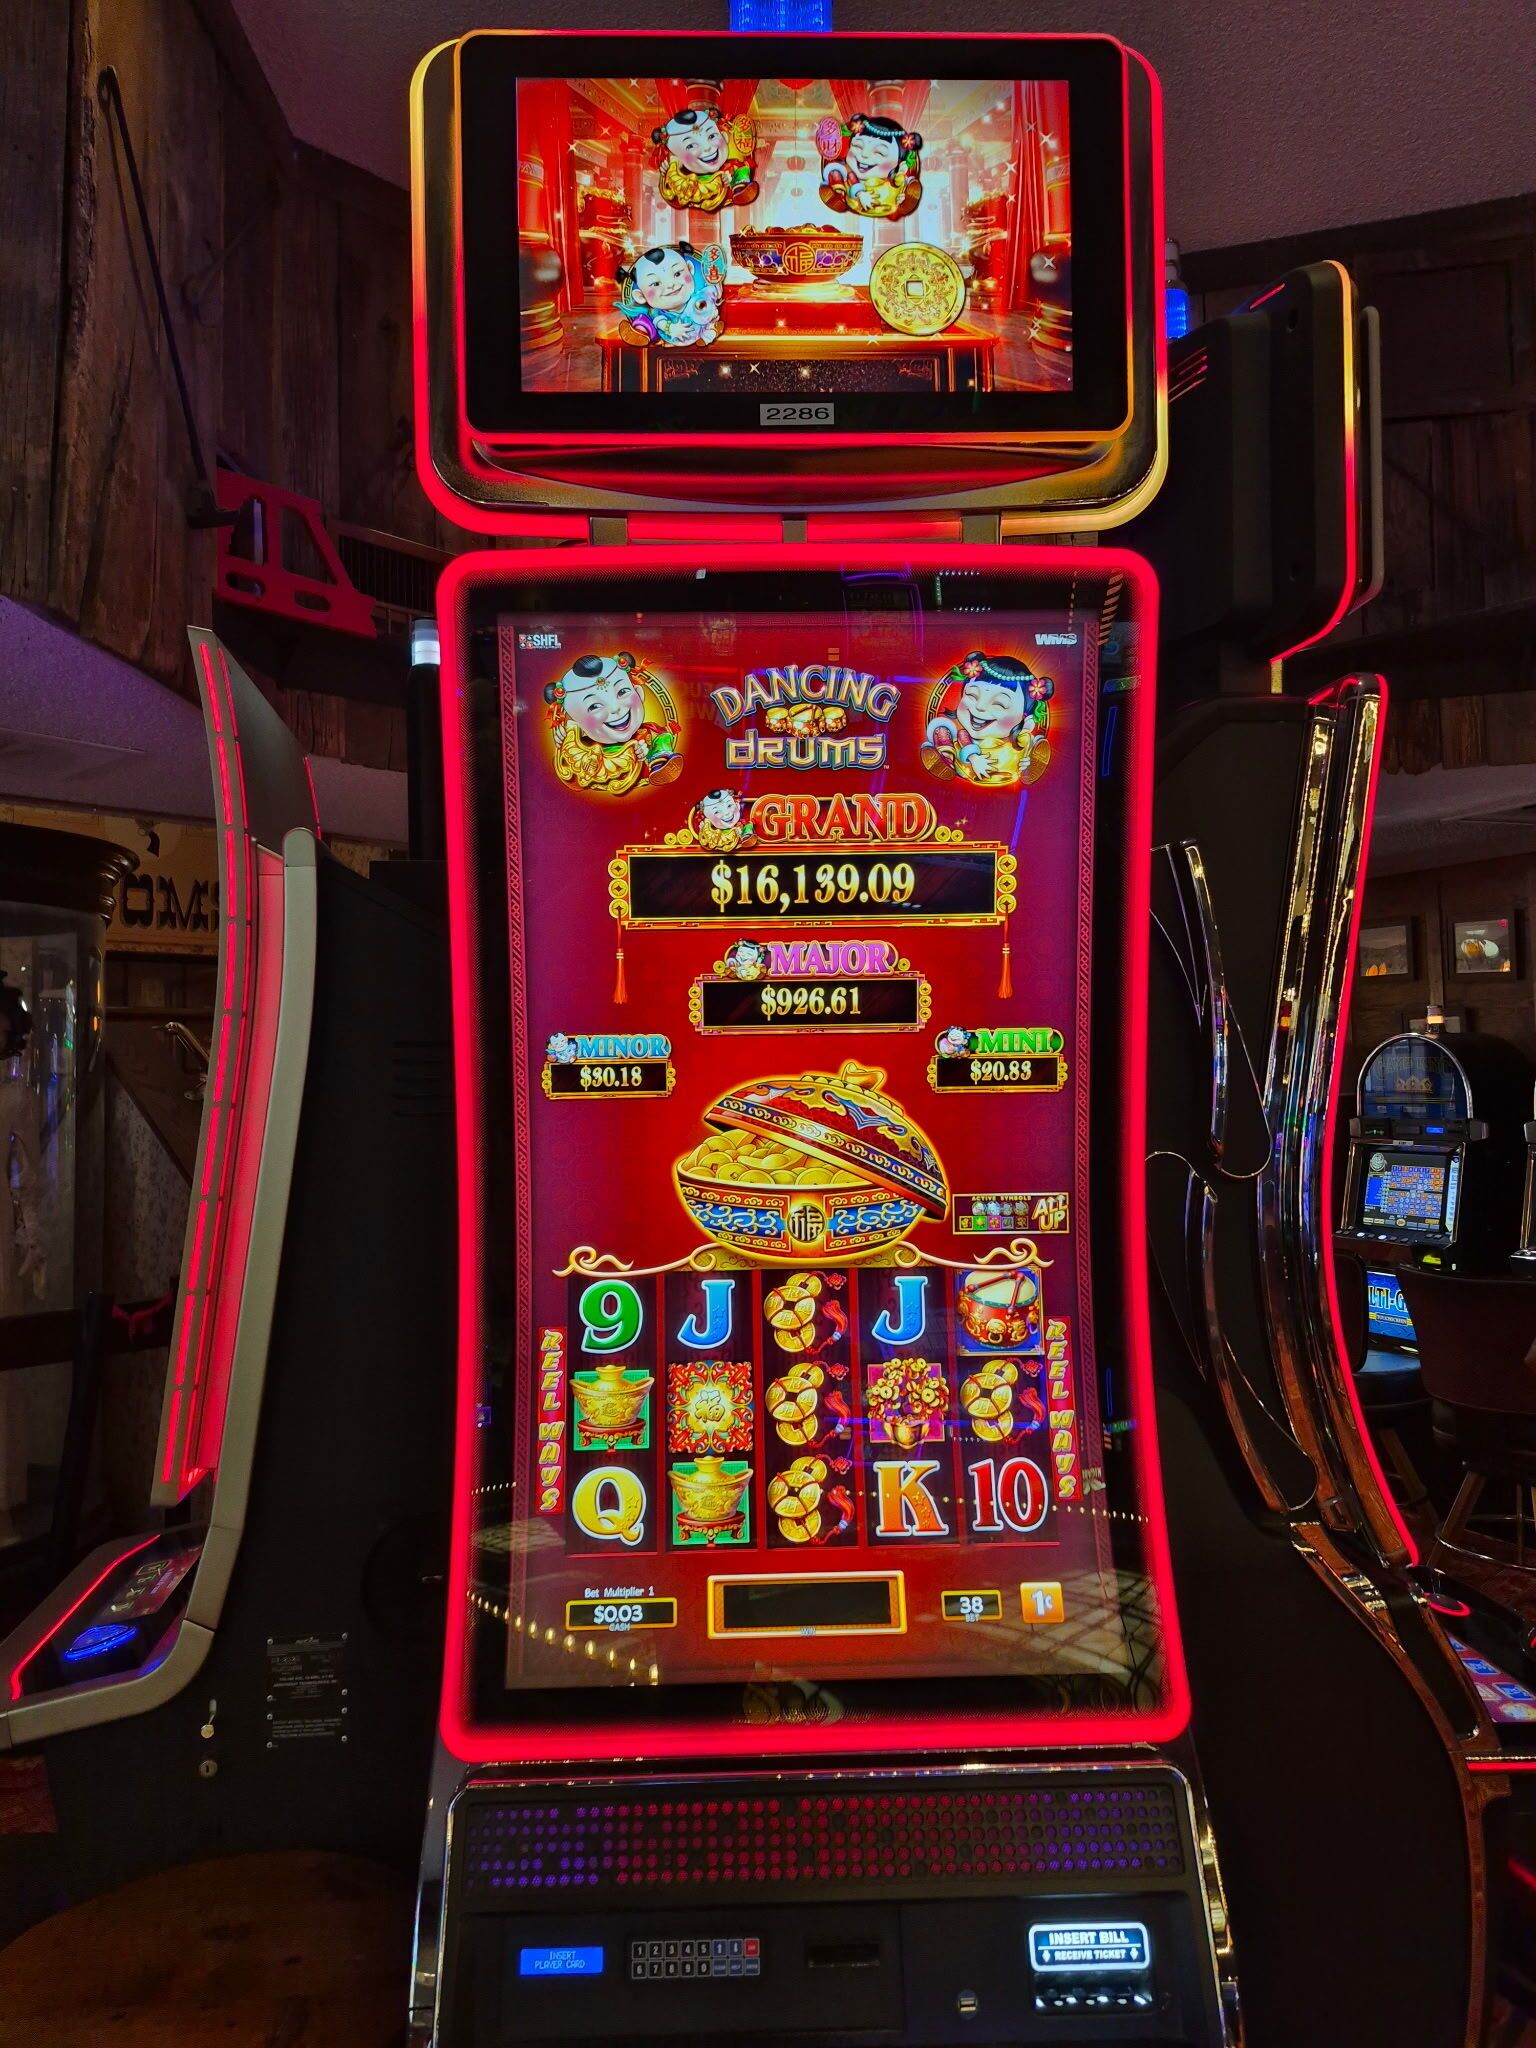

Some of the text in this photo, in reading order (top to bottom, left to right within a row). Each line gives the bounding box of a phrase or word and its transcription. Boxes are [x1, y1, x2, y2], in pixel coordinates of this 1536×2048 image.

[766, 407, 829, 420] 2286
[533, 634, 562, 646] SHFL
[1034, 633, 1078, 645] WMS
[710, 664, 901, 727] DANCING
[750, 793, 931, 843] GRAND
[711, 859, 915, 914] $16,139.09
[768, 940, 894, 976] MAJOR
[761, 984, 861, 1021] $926.61
[575, 1034, 669, 1059] MINOR
[975, 1028, 1054, 1054] MINI
[580, 1065, 642, 1091] $30.18
[970, 1059, 1032, 1085] $20.83
[1031, 1194, 1069, 1220] ALL
[1039, 1210, 1066, 1232] UP
[579, 1278, 644, 1354] 9
[677, 1277, 737, 1350] J
[871, 1274, 928, 1345] J
[539, 1329, 565, 1511] REEL WAYS
[1046, 1319, 1077, 1498] REEL WAYS
[572, 1465, 647, 1545] Q
[872, 1460, 950, 1537] K
[967, 1457, 1049, 1532] 10
[584, 1585, 655, 1598] Bet Multiplier 1
[593, 1604, 644, 1624] $0.03
[960, 1596, 984, 1614] 38
[608, 1623, 631, 1631] CASH
[1049, 1930, 1129, 1945] INSERT BILL
[534, 1959, 586, 1969] PLAYER CARD
[549, 1950, 576, 1960] INSERT
[1054, 1949, 1126, 1960] RECEIVE TICKET
